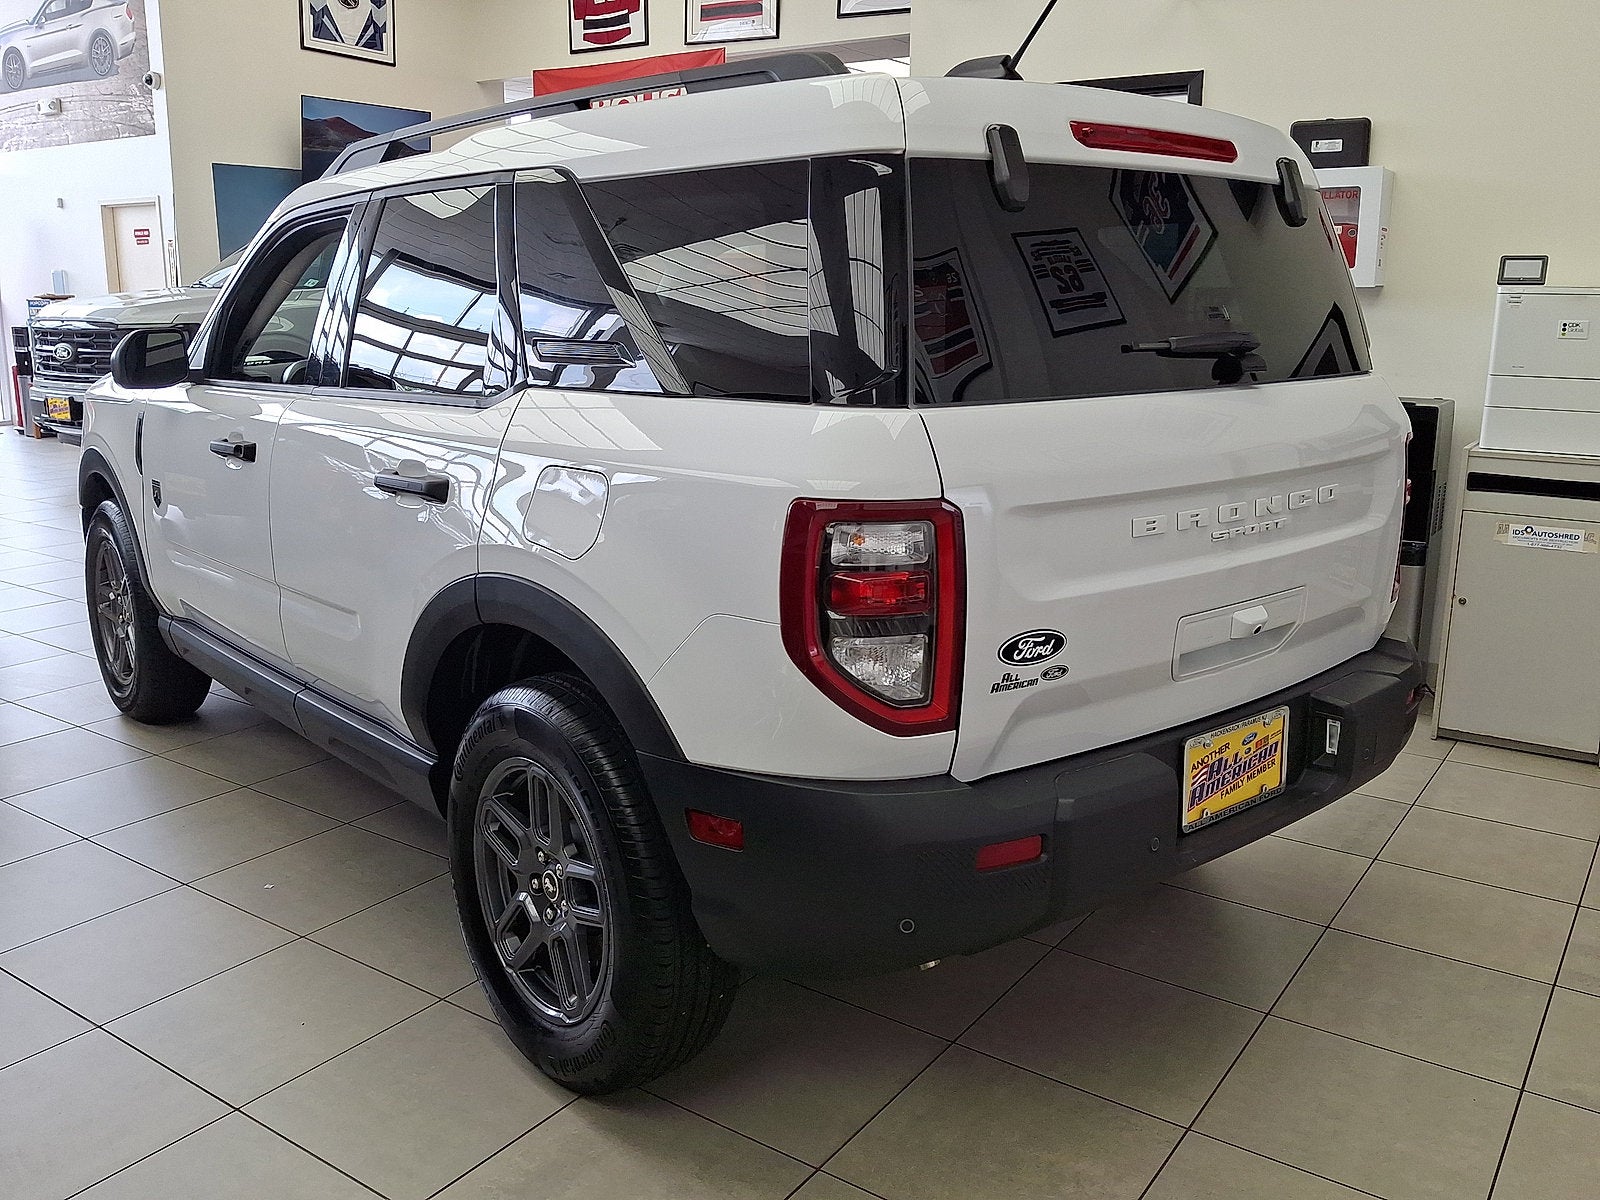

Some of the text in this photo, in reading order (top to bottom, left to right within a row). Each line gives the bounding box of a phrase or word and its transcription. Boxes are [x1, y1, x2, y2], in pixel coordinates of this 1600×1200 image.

[1132, 483, 1339, 538] BRONCO
[1211, 517, 1288, 542] SPORT
[1531, 531, 1580, 541] AUTOSHRED
[1013, 636, 1056, 661] Ford
[1191, 742, 1231, 773] ANOTHER
[1220, 758, 1276, 800] FAMILY MEMBER
[1188, 787, 1282, 832] ALL AMERICAN FORD
